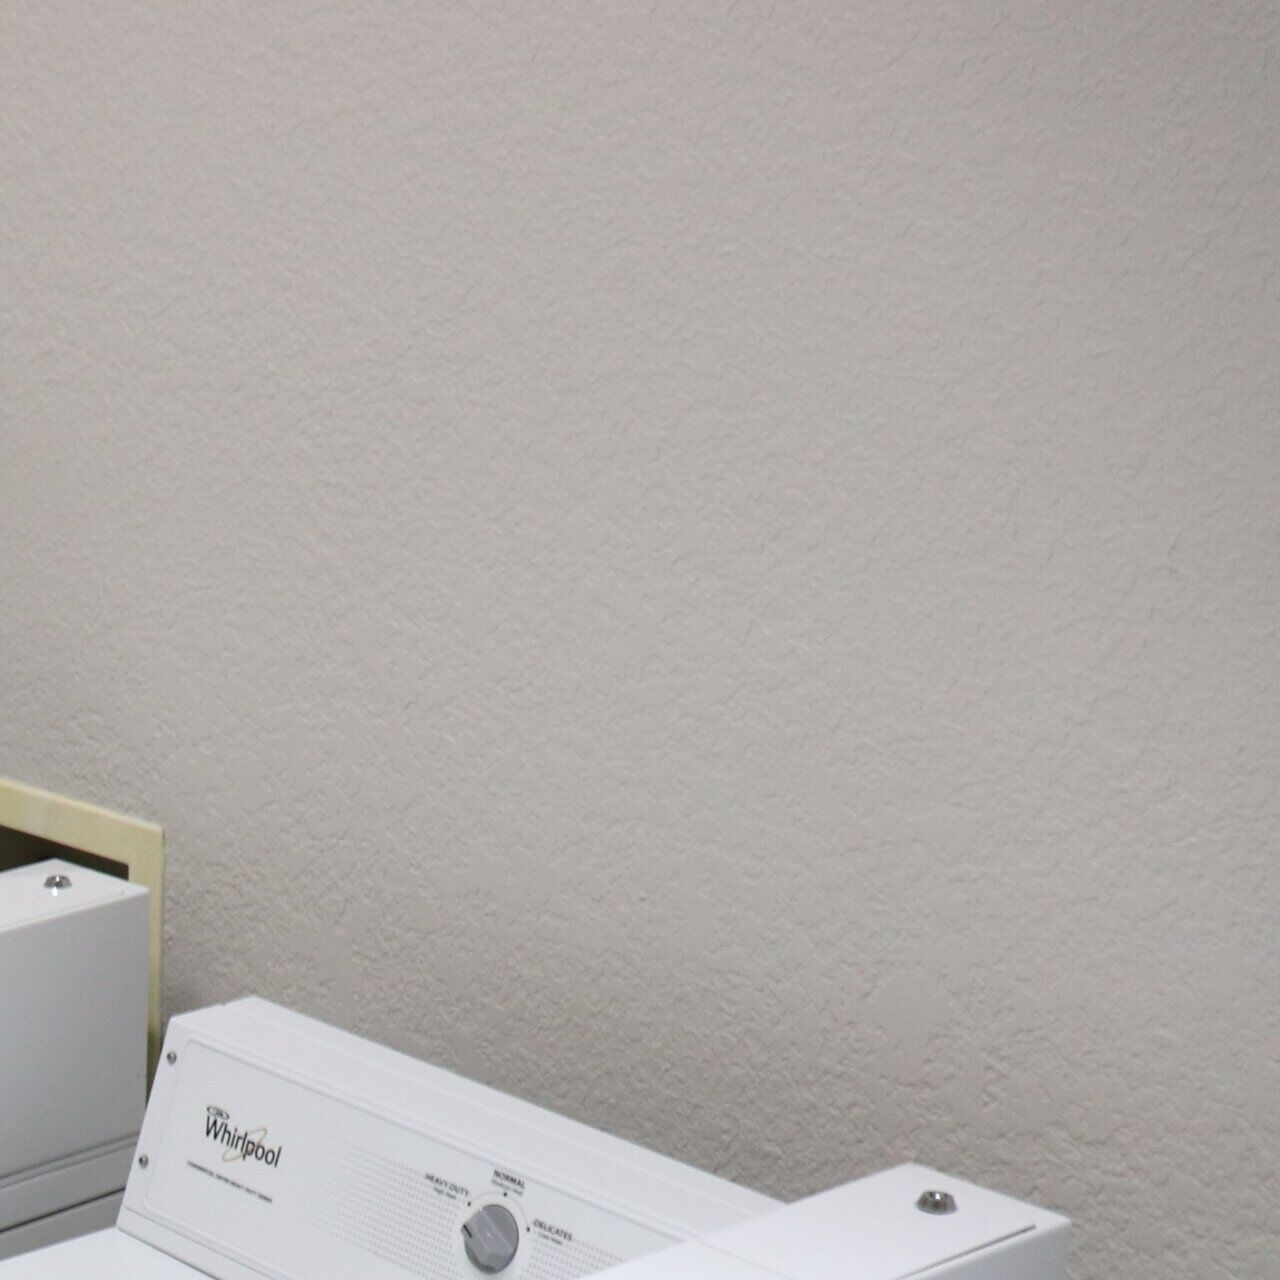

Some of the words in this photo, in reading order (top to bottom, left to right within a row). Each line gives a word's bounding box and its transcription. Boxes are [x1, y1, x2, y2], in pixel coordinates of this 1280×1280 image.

[205, 1114, 282, 1169] Whirlpool
[424, 1172, 448, 1188] HEAVY
[449, 1182, 470, 1197] DUTY
[493, 1169, 526, 1190] NORMAL
[533, 1219, 573, 1242] DELICATES
